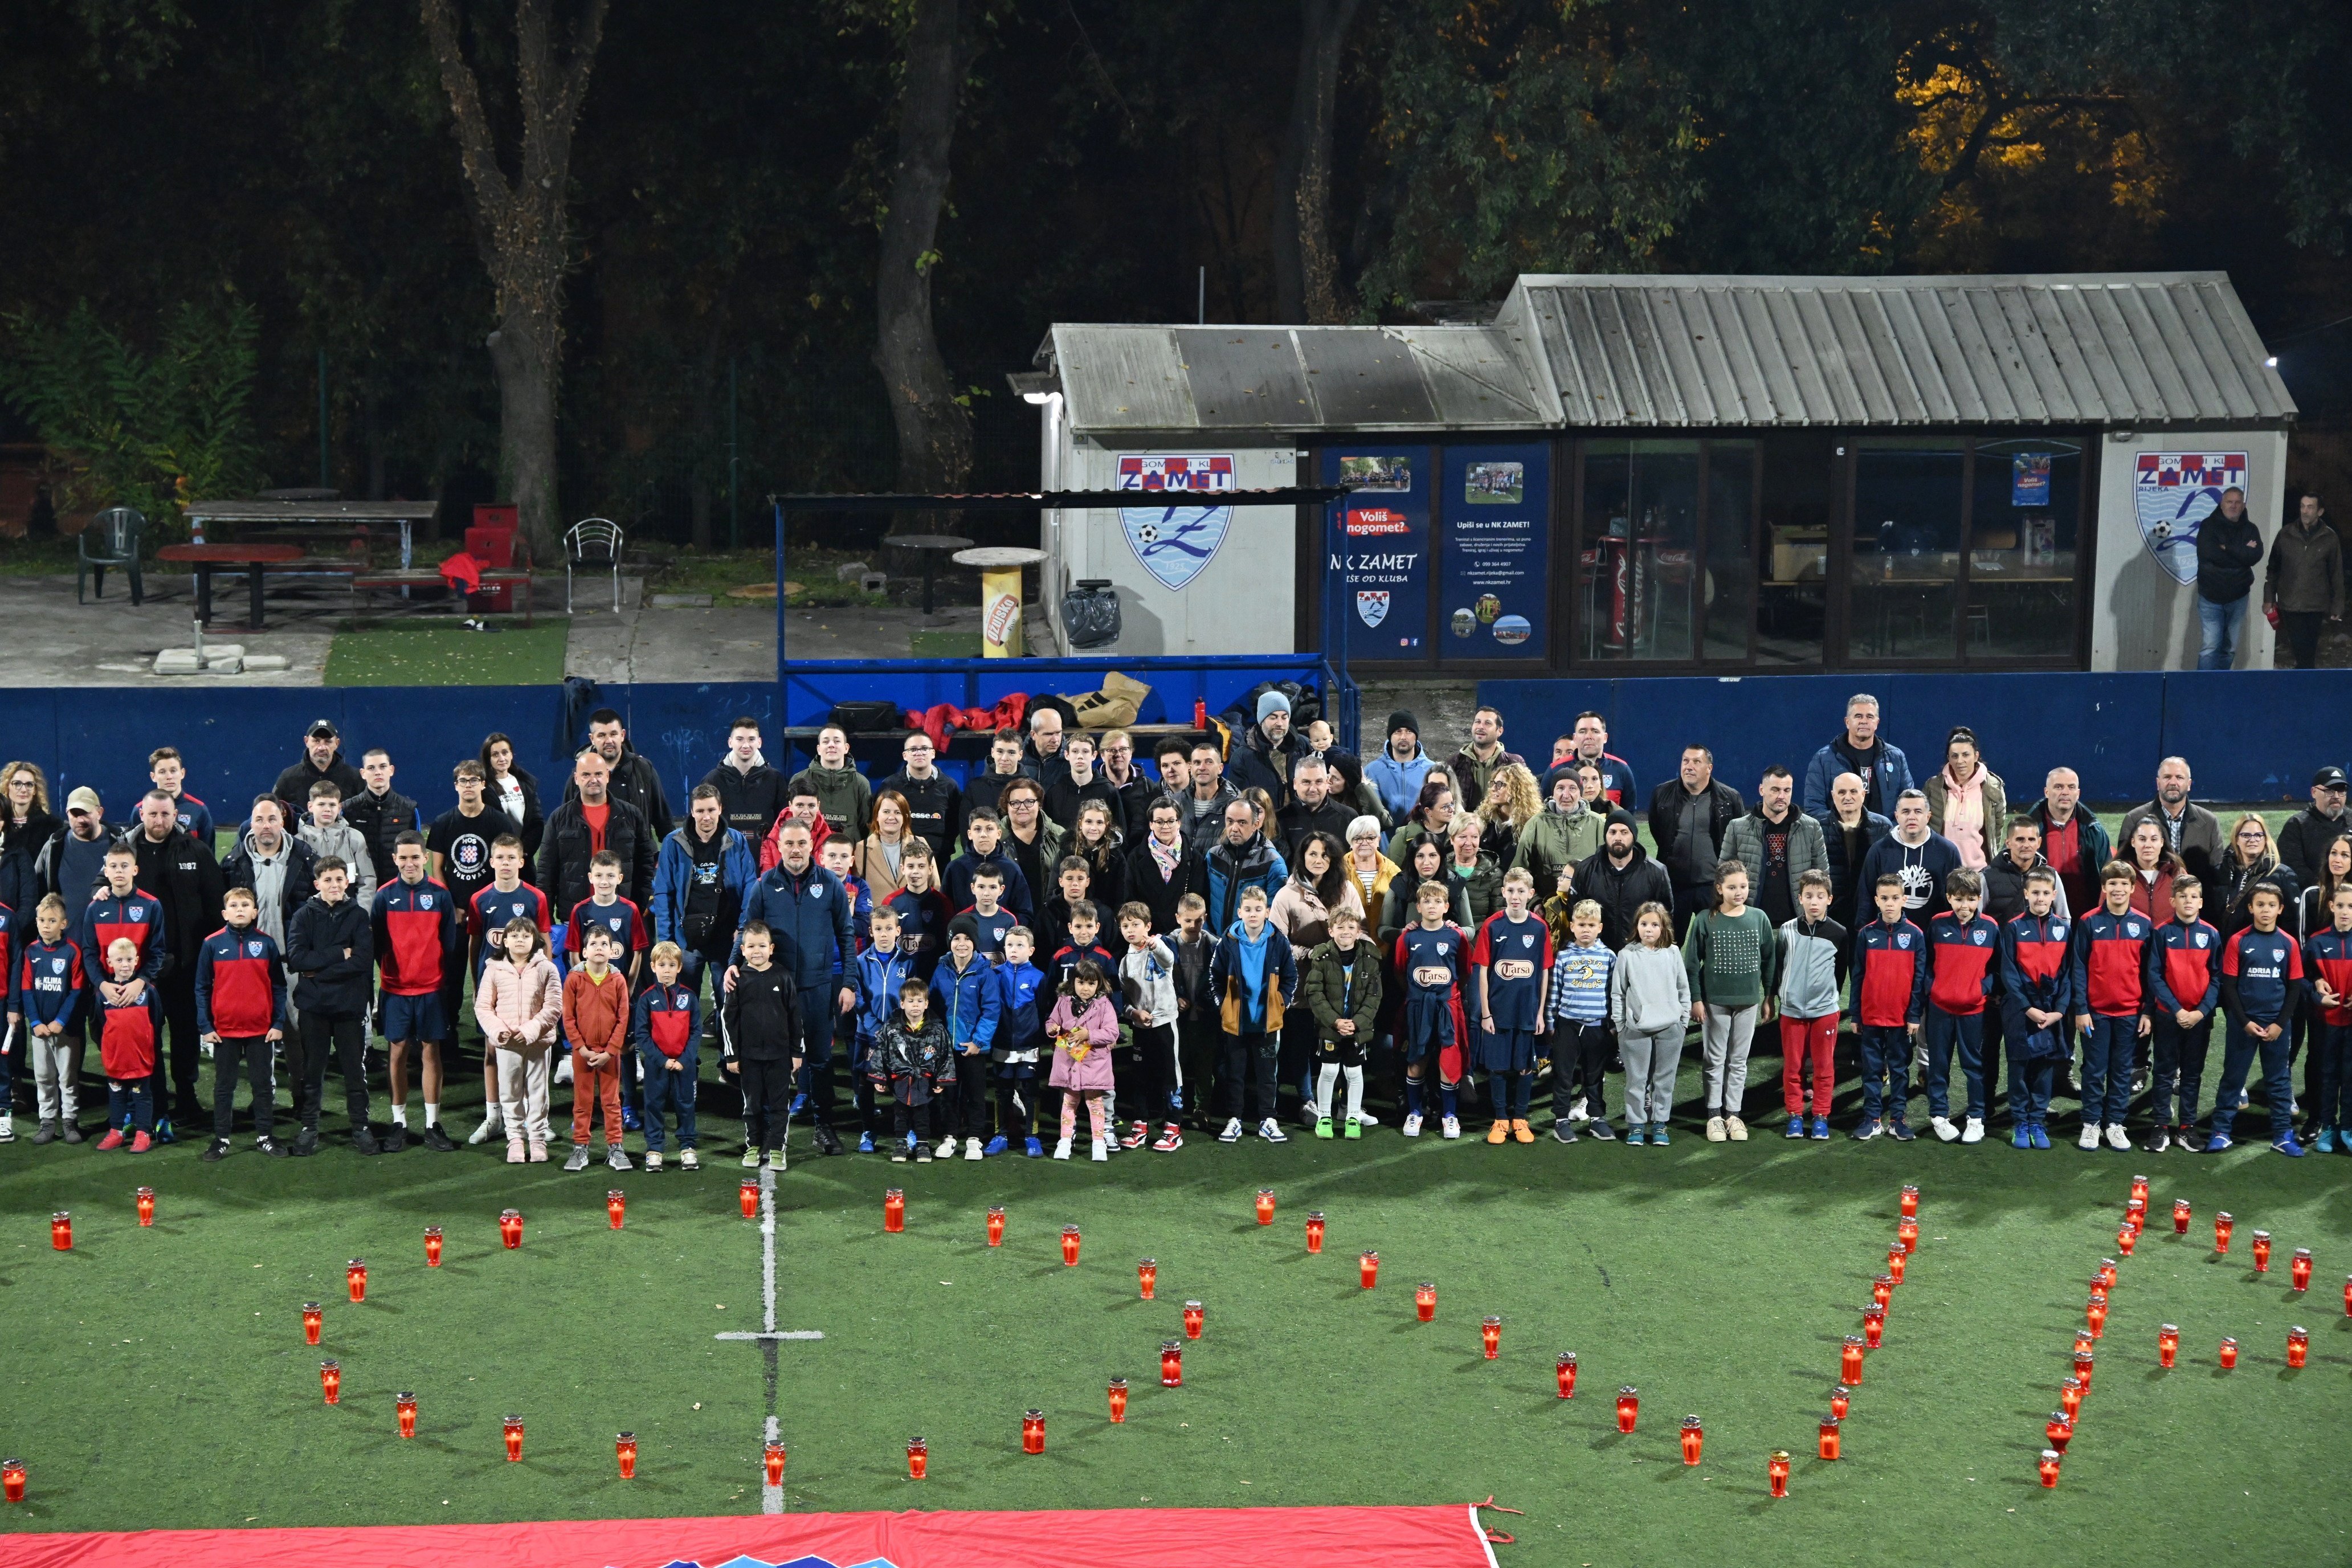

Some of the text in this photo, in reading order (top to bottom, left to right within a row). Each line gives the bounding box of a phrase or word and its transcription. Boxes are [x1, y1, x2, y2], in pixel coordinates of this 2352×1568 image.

[1122, 469, 1227, 487] ZAMET
[2139, 467, 2240, 484] ZAMET
[1360, 511, 1387, 521] Voliš
[1347, 521, 1405, 534] nogomet?
[1359, 553, 1418, 570] ZAMET
[1346, 574, 1359, 582] IŠE
[453, 868, 487, 881] VUKOVAR
[1501, 962, 1530, 978] Tarsa
[1566, 957, 1586, 972] WOLF
[1418, 969, 1448, 985] Tarsa
[1571, 978, 1602, 989] MOTORS
